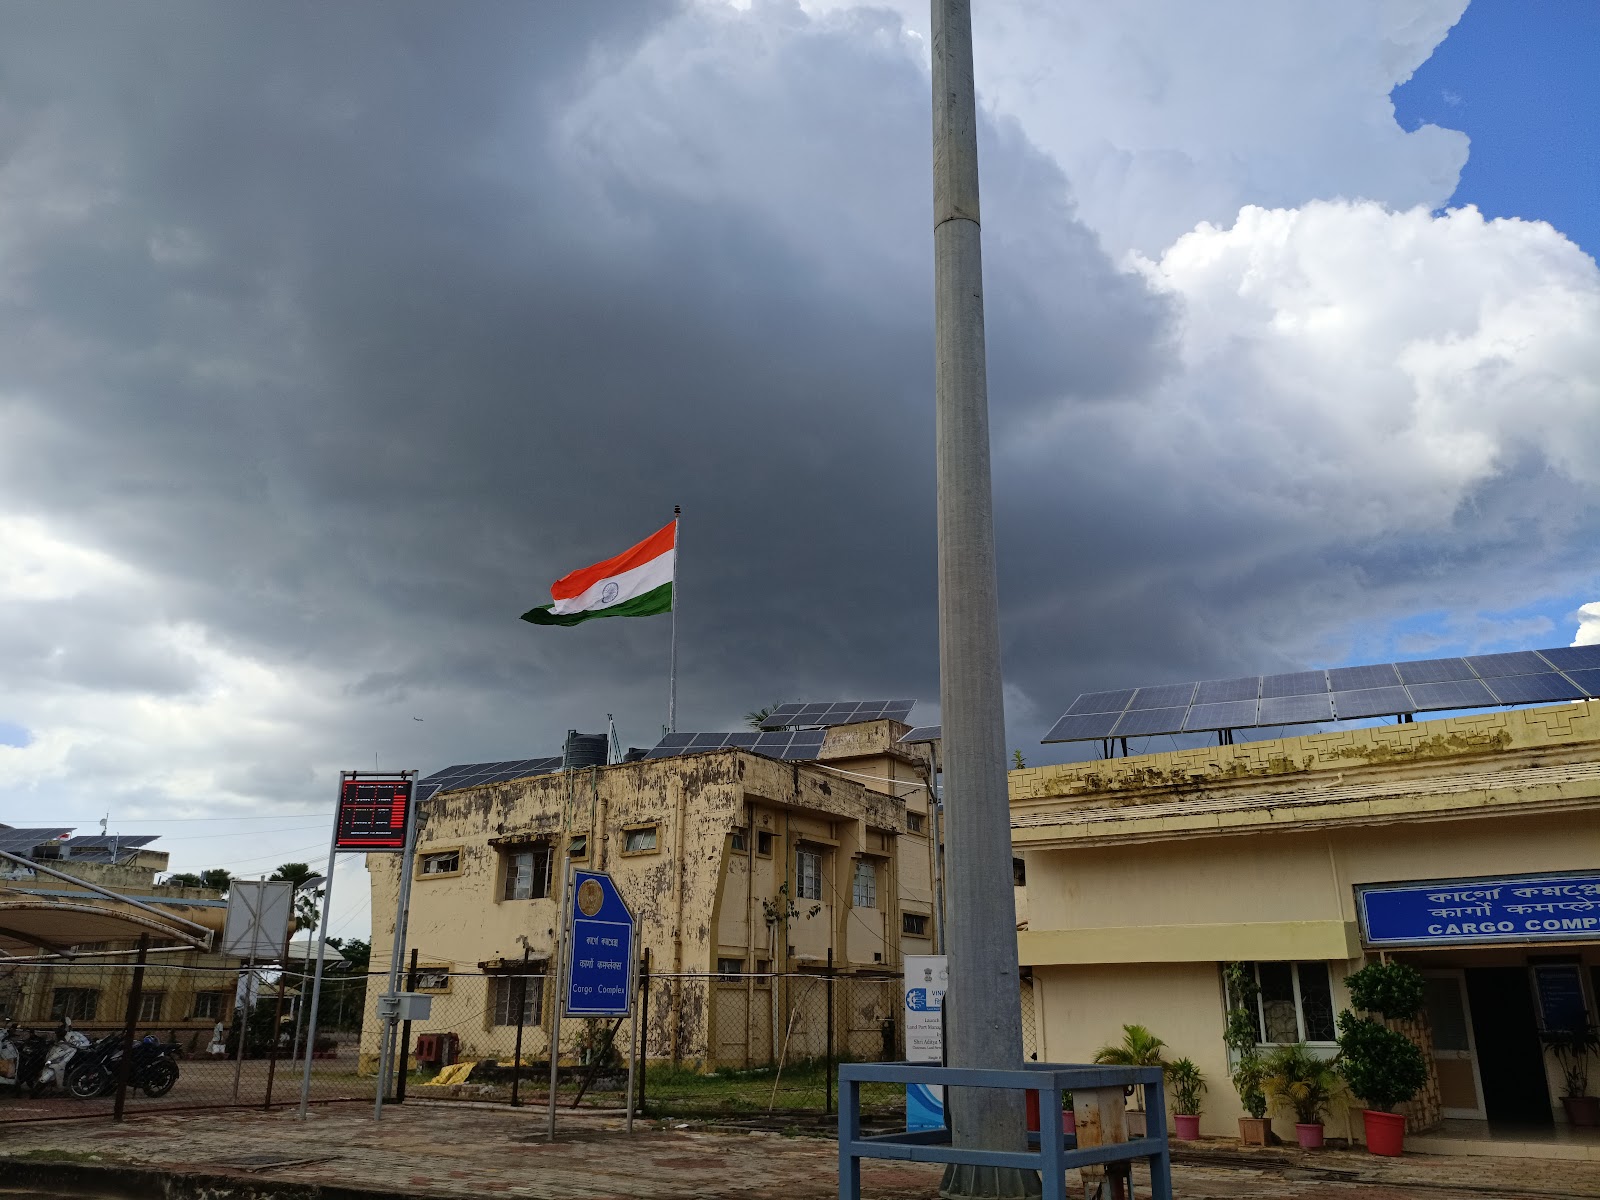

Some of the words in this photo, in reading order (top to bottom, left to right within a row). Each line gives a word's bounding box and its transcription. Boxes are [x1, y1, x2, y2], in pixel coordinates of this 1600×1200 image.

[1427, 902, 1492, 918] कार्गो
[1502, 896, 1600, 915] कमप्ले
[1427, 921, 1515, 935] CARGO
[1525, 917, 1600, 931] COMP
[572, 983, 593, 995] Cargo
[597, 984, 625, 996] Complex
